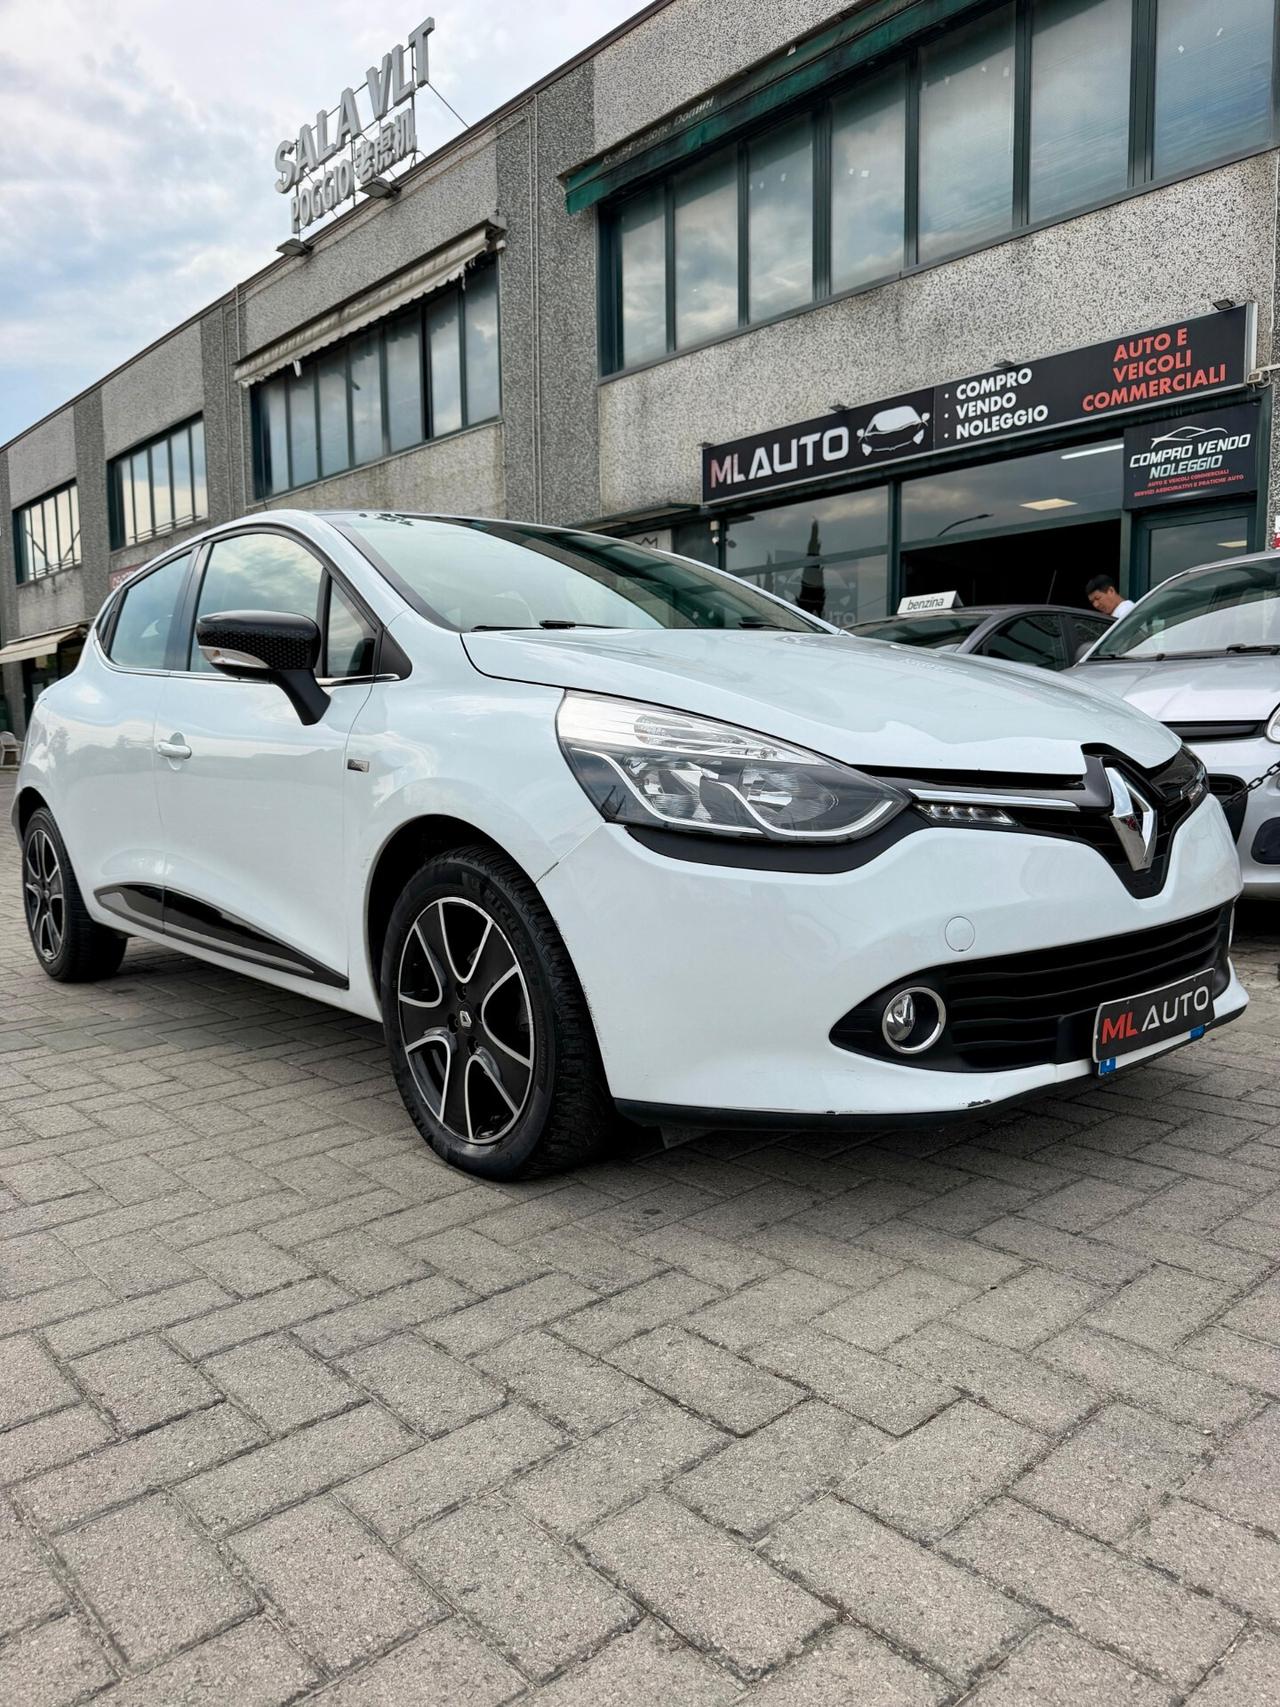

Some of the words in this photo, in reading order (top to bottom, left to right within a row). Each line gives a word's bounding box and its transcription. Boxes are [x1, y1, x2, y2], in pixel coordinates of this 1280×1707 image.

[275, 87, 362, 194] SALA
[366, 16, 435, 121] VLT
[354, 108, 417, 185] 老虎机
[291, 159, 352, 234] POGGIO
[1113, 333, 1171, 362] AUTO
[1177, 327, 1188, 346] E
[956, 368, 1032, 400] COMPRO
[1113, 350, 1192, 383] VEICOLI
[1082, 363, 1226, 411] COMMERCIALI
[956, 392, 1017, 420] VENDO
[956, 405, 1048, 440] NOLEGGIO
[748, 426, 849, 480] AUTO
[1129, 445, 1193, 468] COMPRO
[1197, 434, 1251, 455] VENDO
[1149, 455, 1223, 479] NOLEGGIO
[907, 597, 944, 610] benzina
[1102, 1012, 1137, 1044] ML
[1142, 986, 1209, 1032] AUTO
